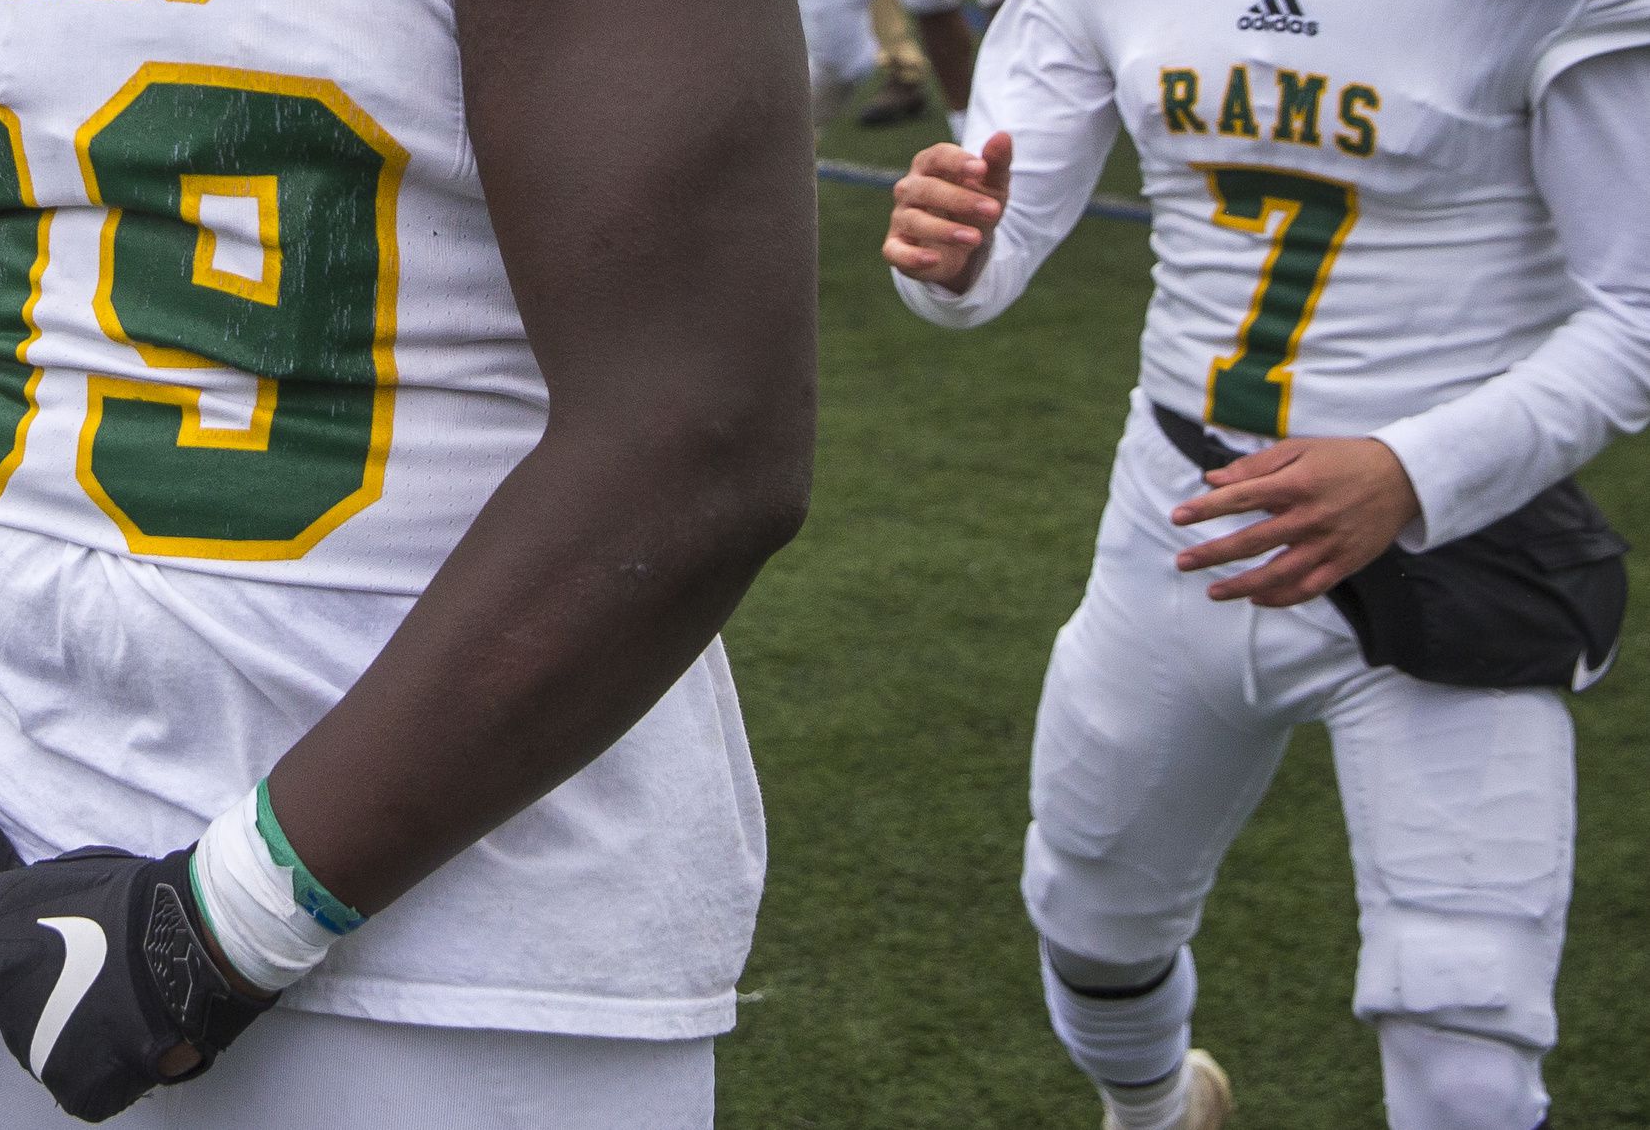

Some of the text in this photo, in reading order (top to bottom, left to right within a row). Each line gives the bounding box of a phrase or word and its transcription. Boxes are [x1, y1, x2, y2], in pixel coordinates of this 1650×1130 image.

[1236, 14, 1319, 37] adidas
[1159, 63, 1381, 159] RAMS
[1188, 160, 1360, 439] 7
